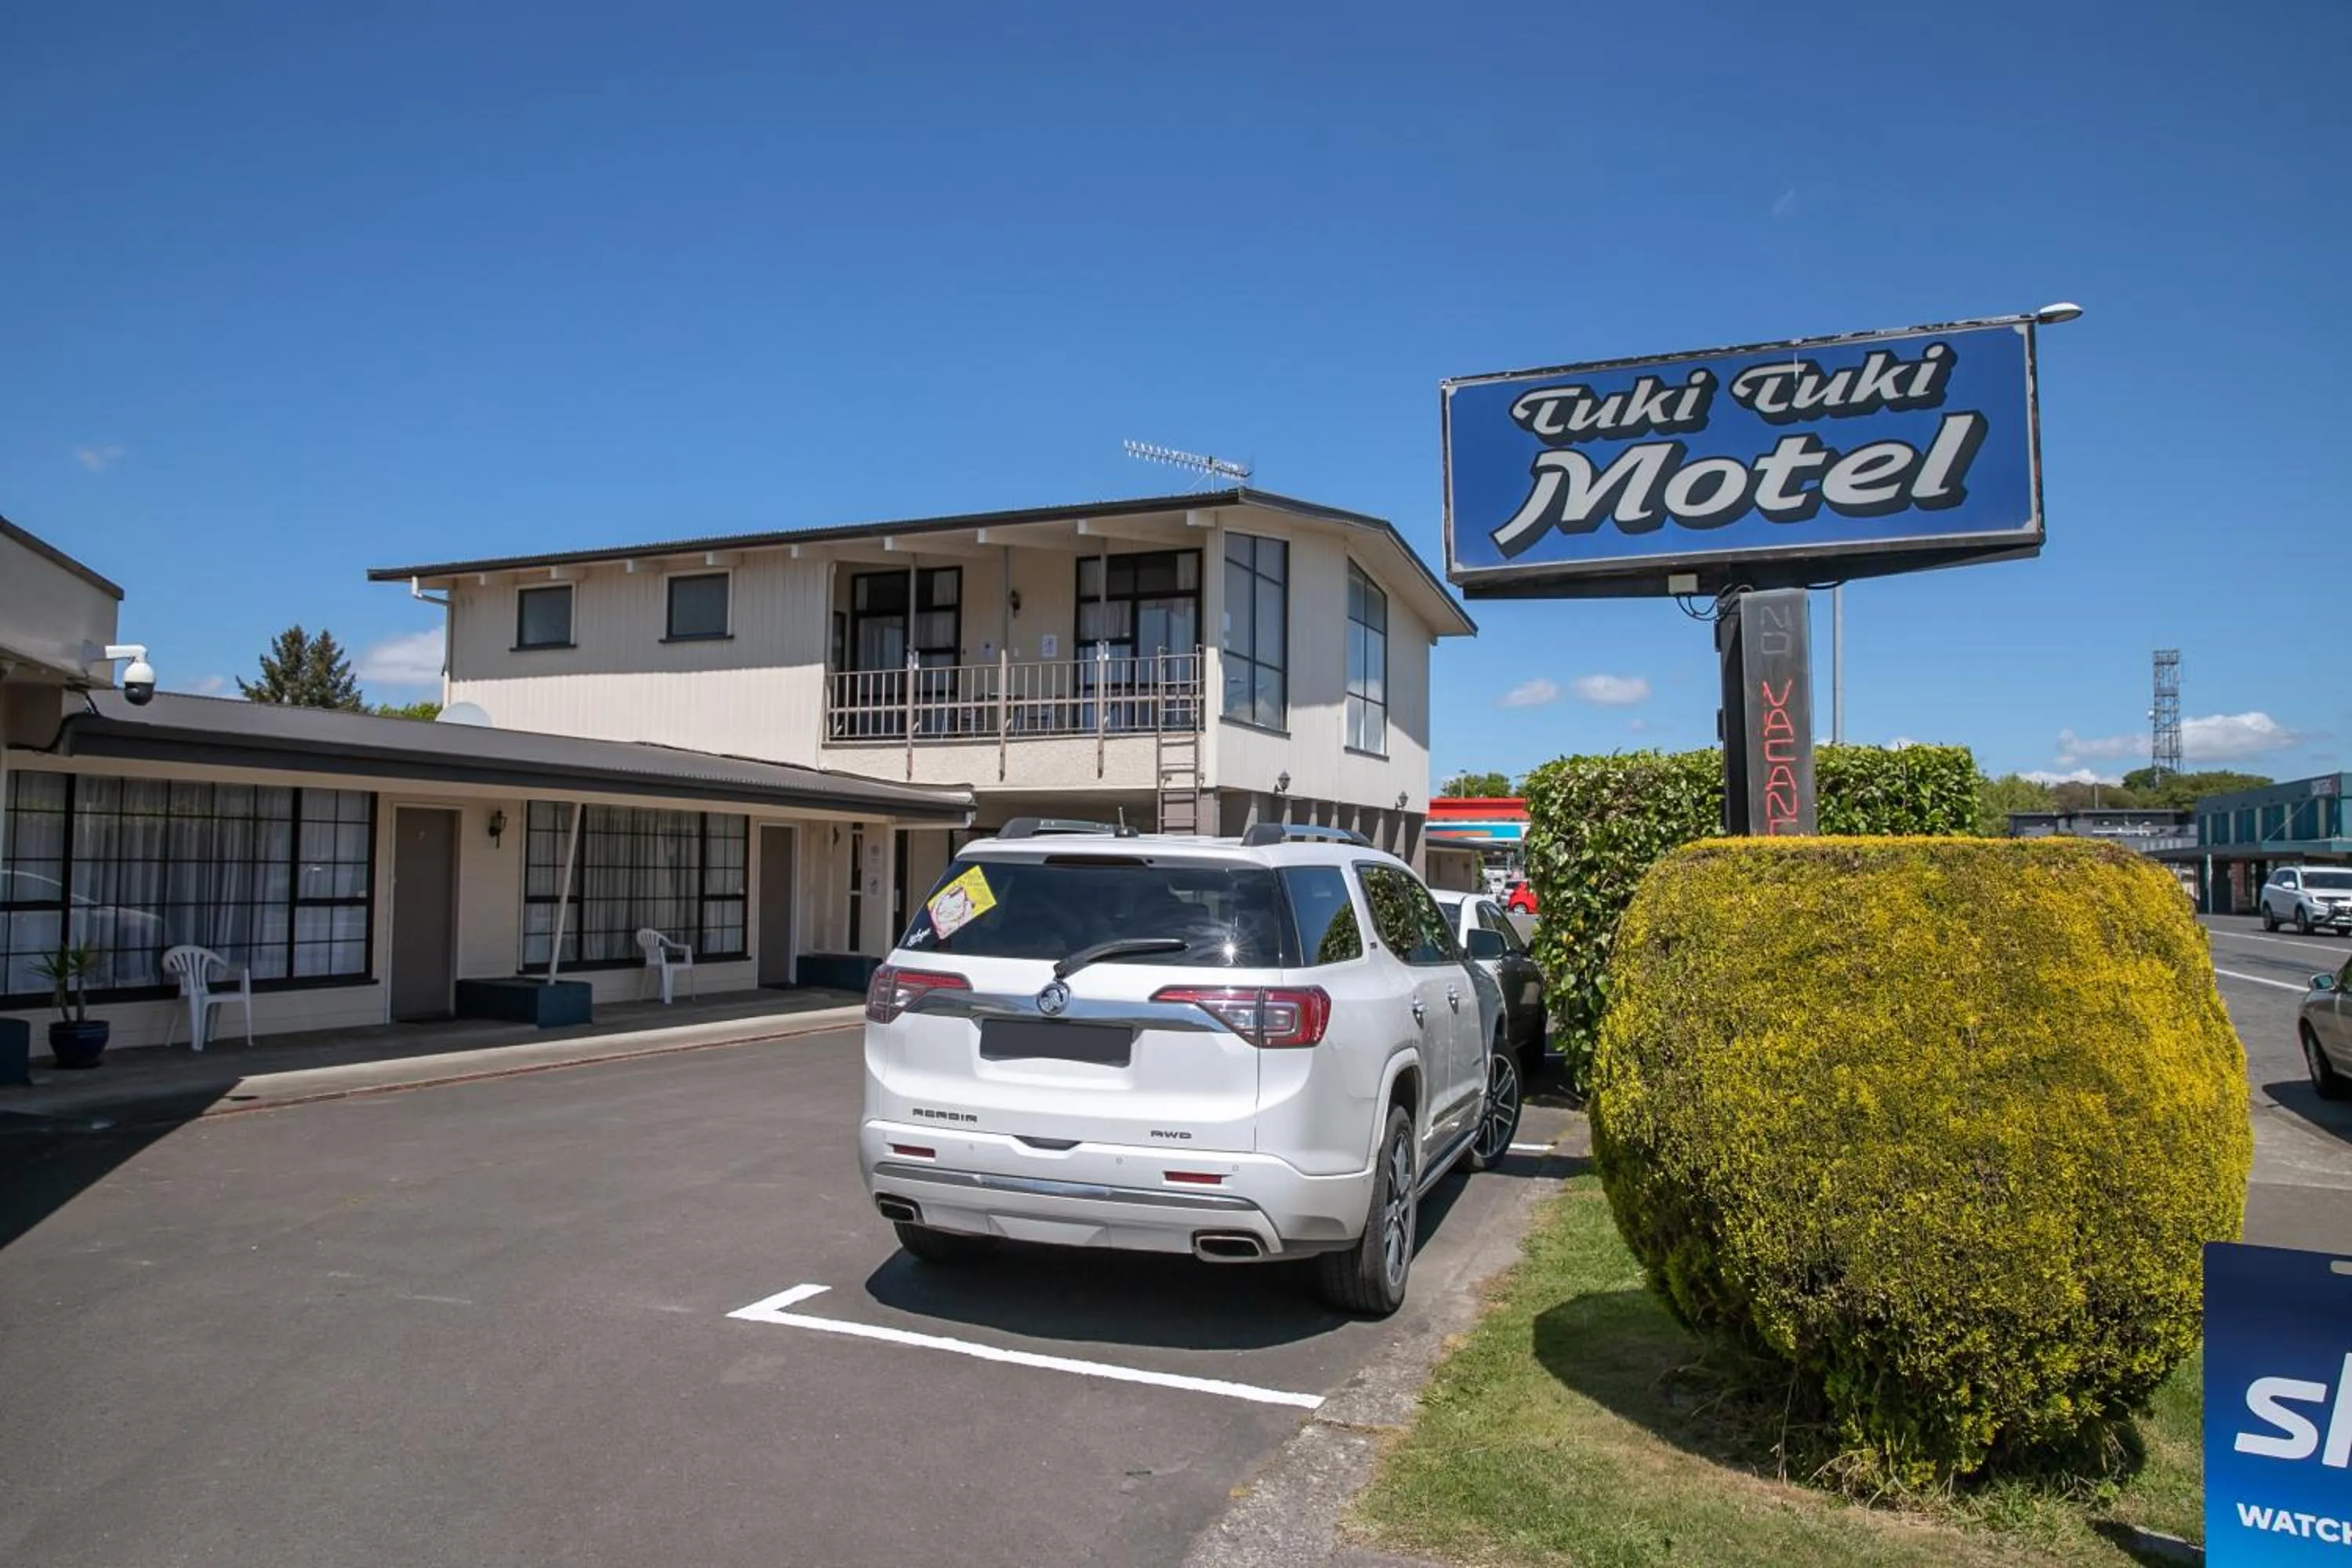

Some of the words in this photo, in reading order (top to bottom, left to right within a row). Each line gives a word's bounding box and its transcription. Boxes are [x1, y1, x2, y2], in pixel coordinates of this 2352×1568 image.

[1512, 370, 1710, 436] Tuki
[1731, 344, 1947, 414] Tuki
[1492, 414, 1975, 546] Motel
[1150, 1130, 1192, 1139] AWD
